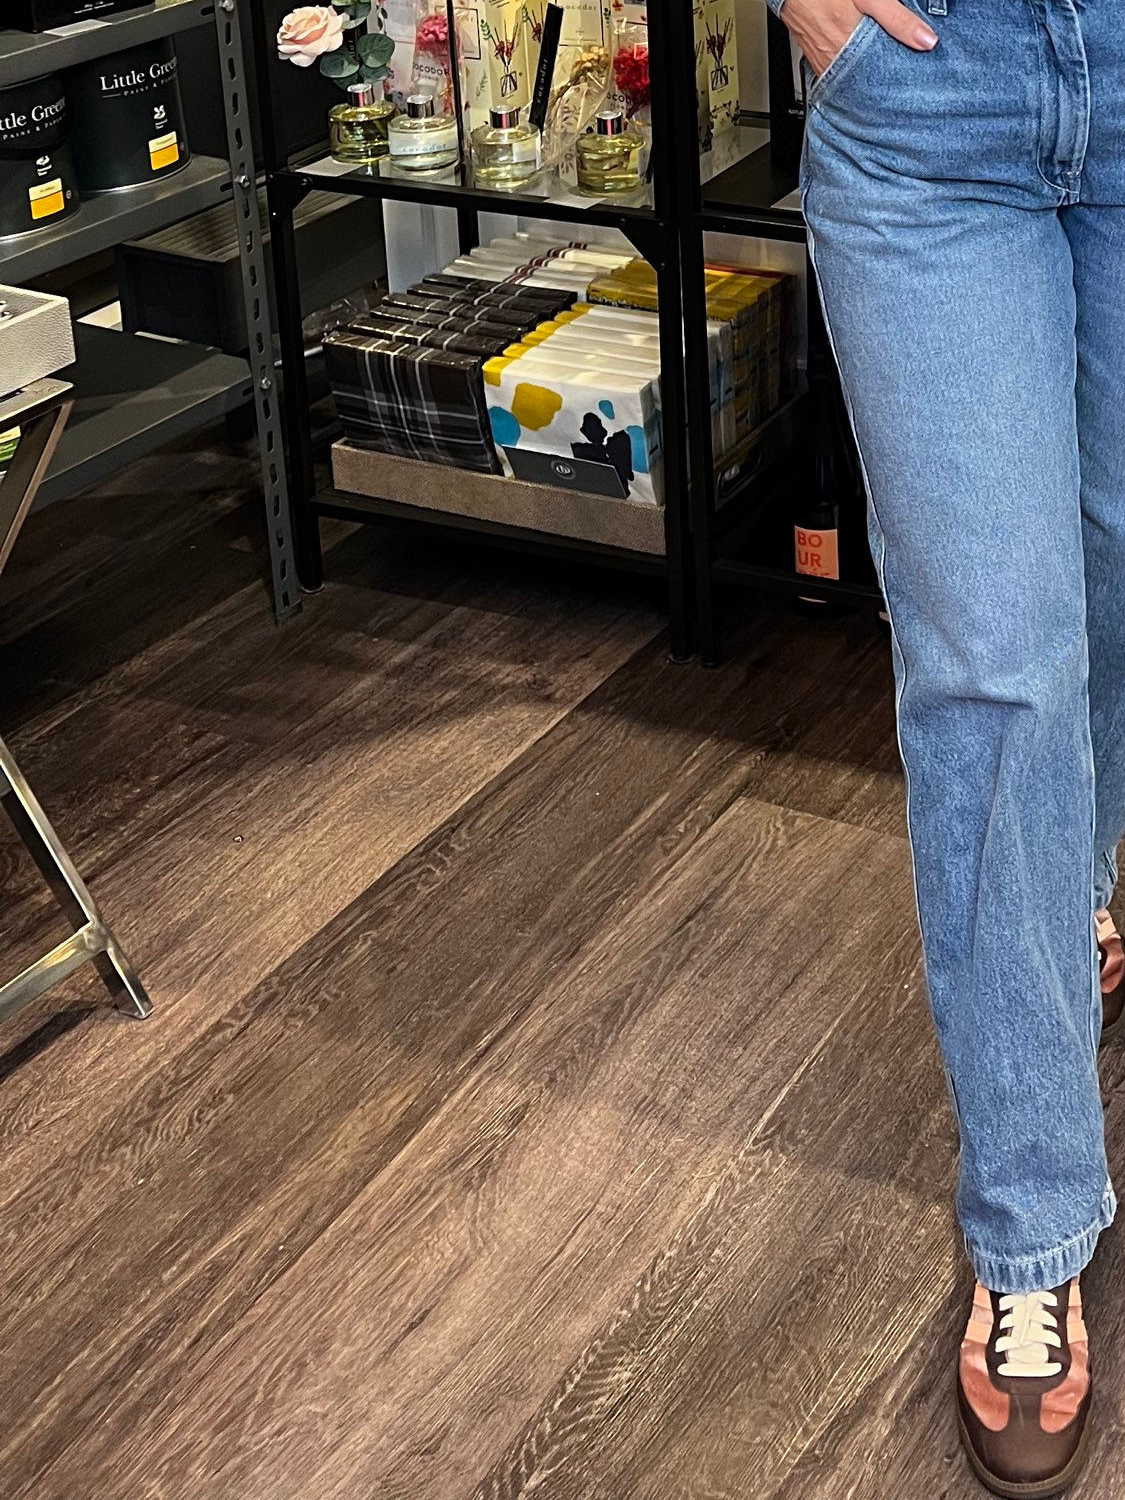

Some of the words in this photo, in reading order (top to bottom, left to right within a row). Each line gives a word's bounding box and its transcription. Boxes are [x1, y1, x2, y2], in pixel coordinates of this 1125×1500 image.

[100, 70, 146, 91] Little
[798, 530, 823, 548] BO
[798, 550, 822, 568] UR
